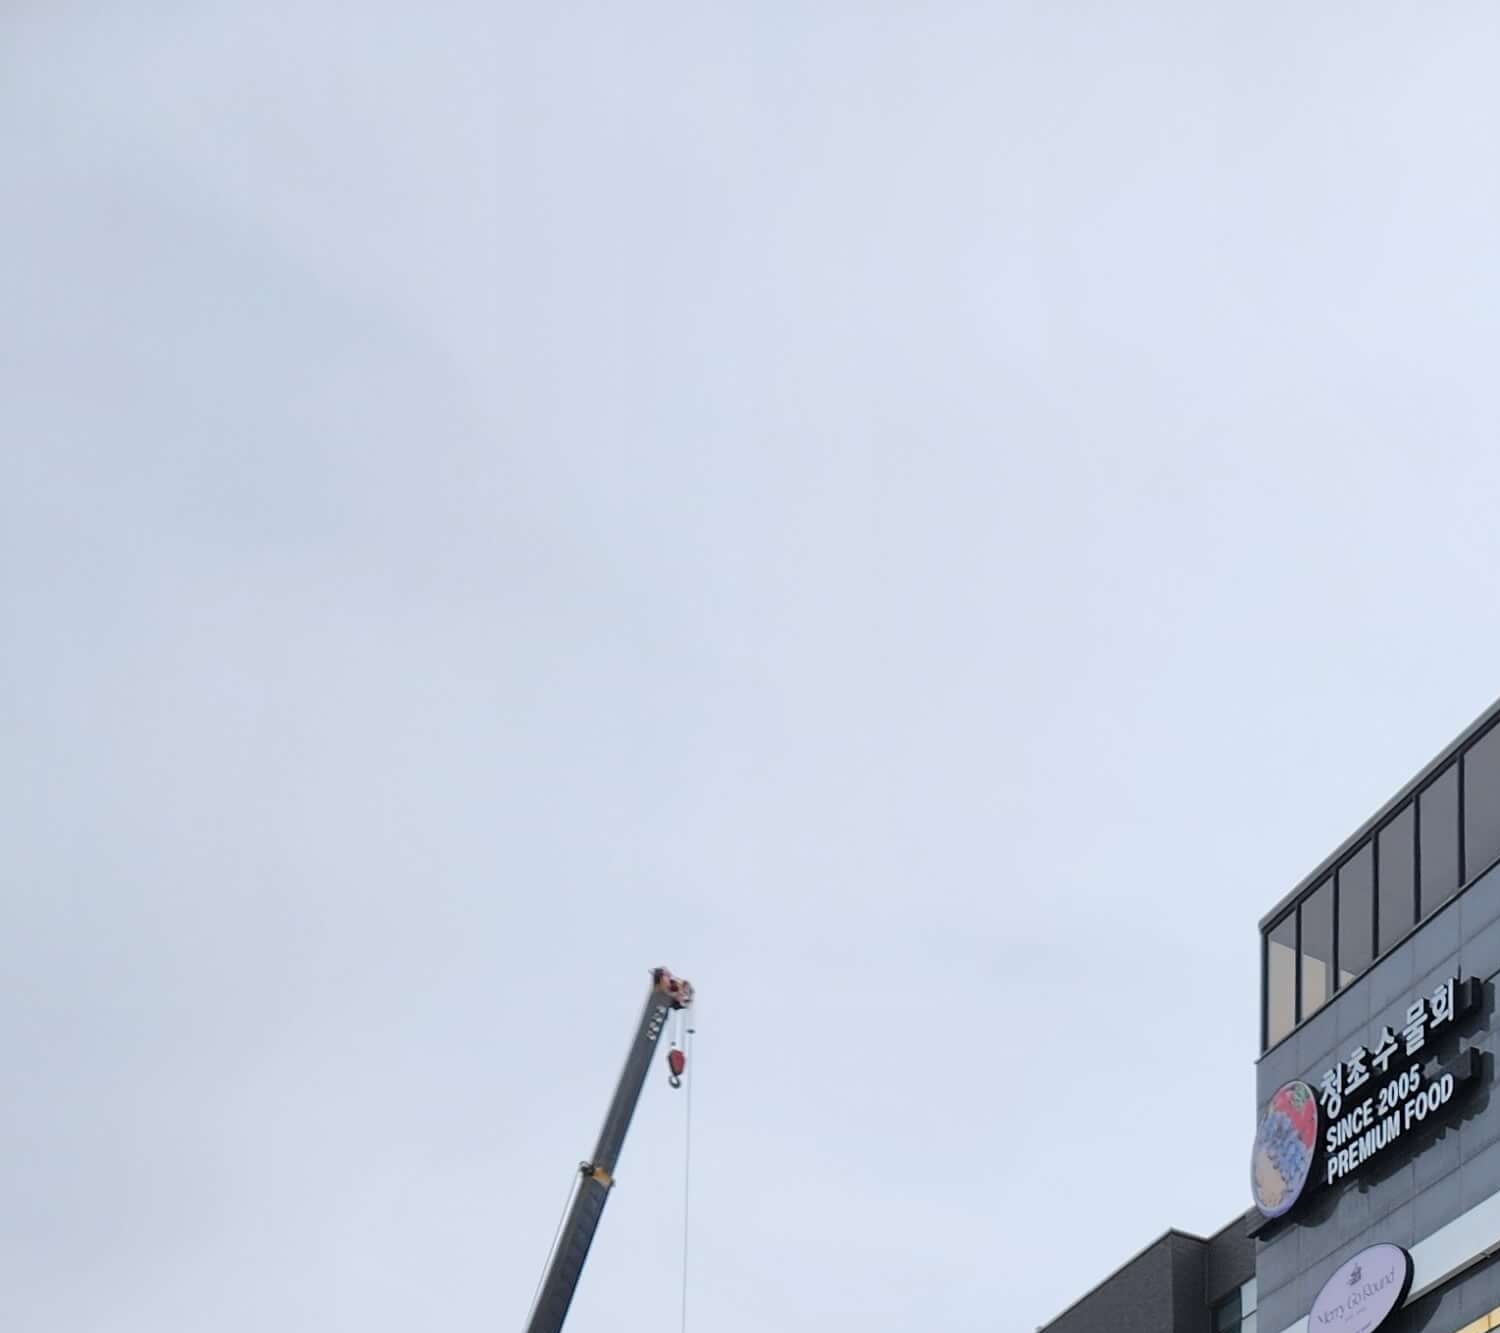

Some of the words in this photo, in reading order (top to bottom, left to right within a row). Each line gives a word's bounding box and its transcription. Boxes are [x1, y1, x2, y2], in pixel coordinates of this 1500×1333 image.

[1320, 977, 1455, 1119] 청초수물회
[1326, 1098, 1373, 1153] SINCE
[1377, 1063, 1421, 1117] 2005
[1327, 1110, 1400, 1185] PREMIUM
[1404, 1073, 1454, 1130] FOOD
